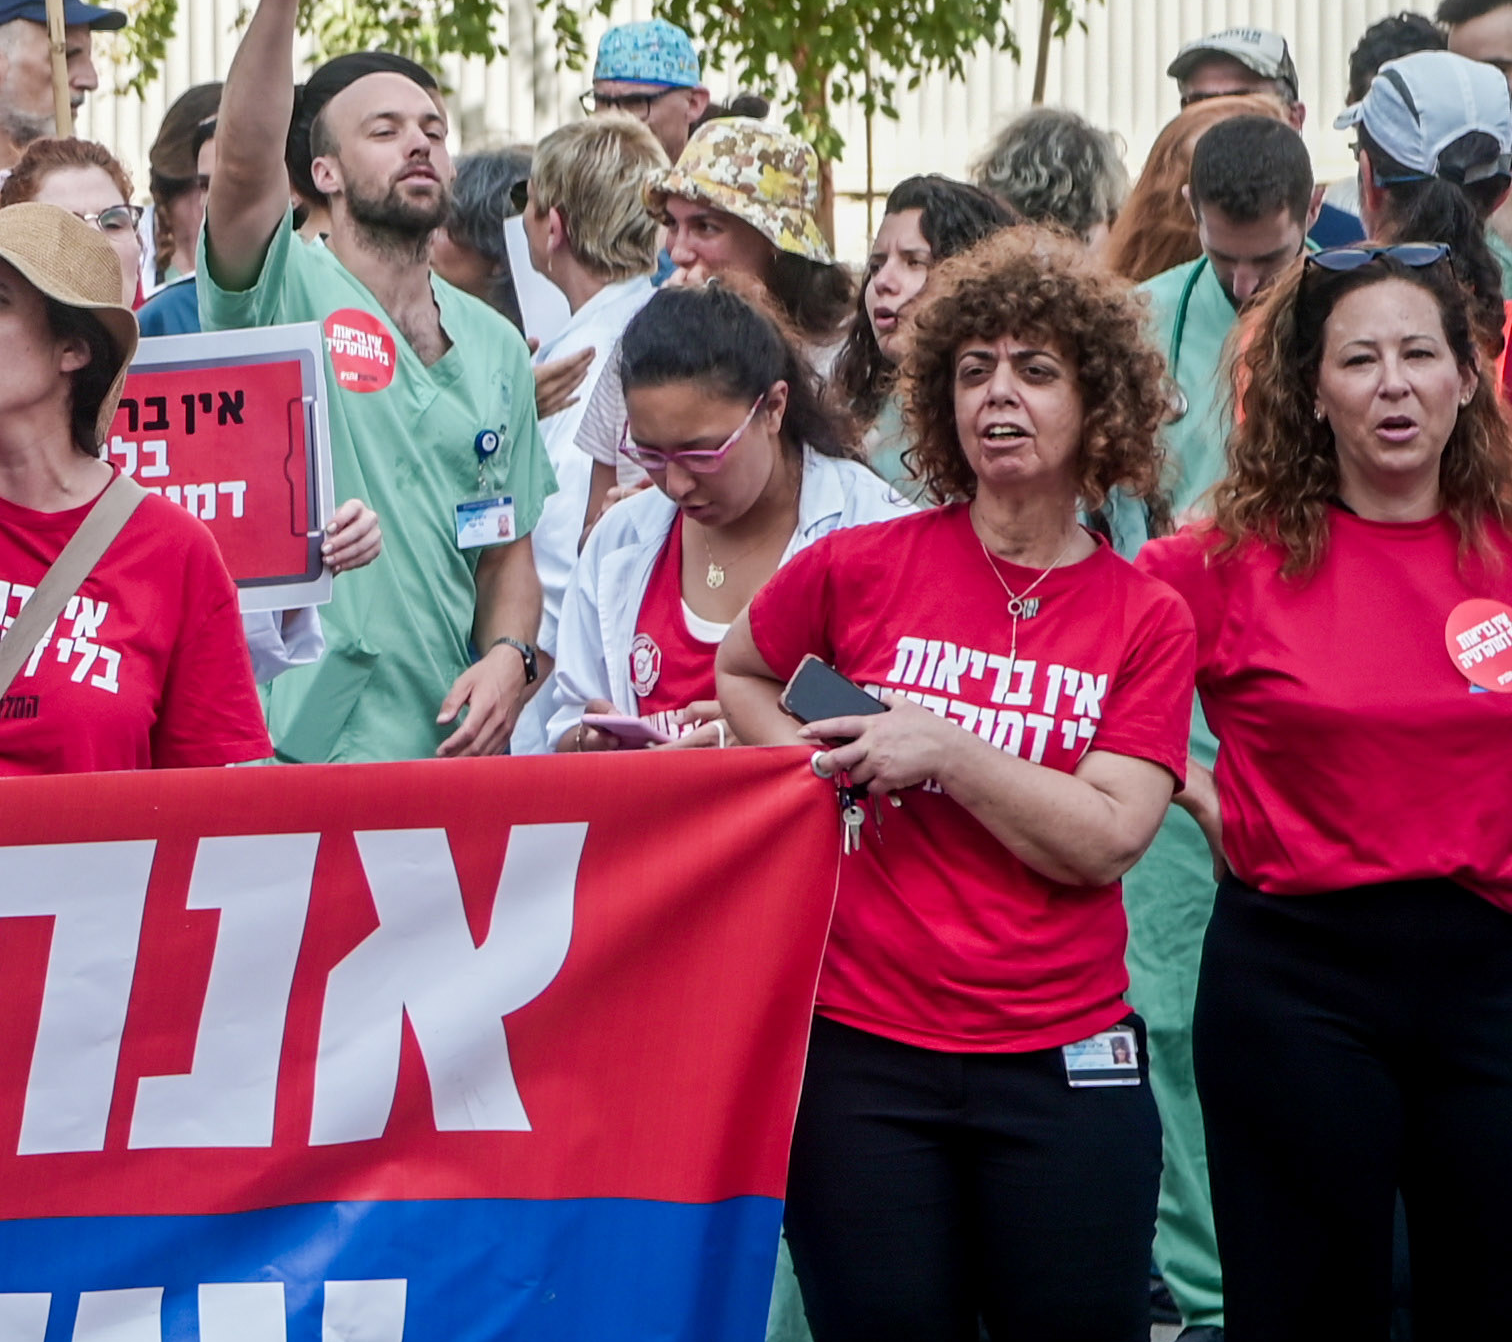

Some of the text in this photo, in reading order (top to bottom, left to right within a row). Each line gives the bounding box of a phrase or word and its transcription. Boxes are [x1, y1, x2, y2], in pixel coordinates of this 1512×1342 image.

[333, 323, 368, 346] בריאות
[181, 390, 246, 435] אין
[43, 595, 109, 638] אי
[1455, 619, 1498, 651] בריאות
[57, 637, 122, 694] בלי
[885, 636, 1109, 719] אין בריאות
[864, 683, 1097, 765] לי דמוק
